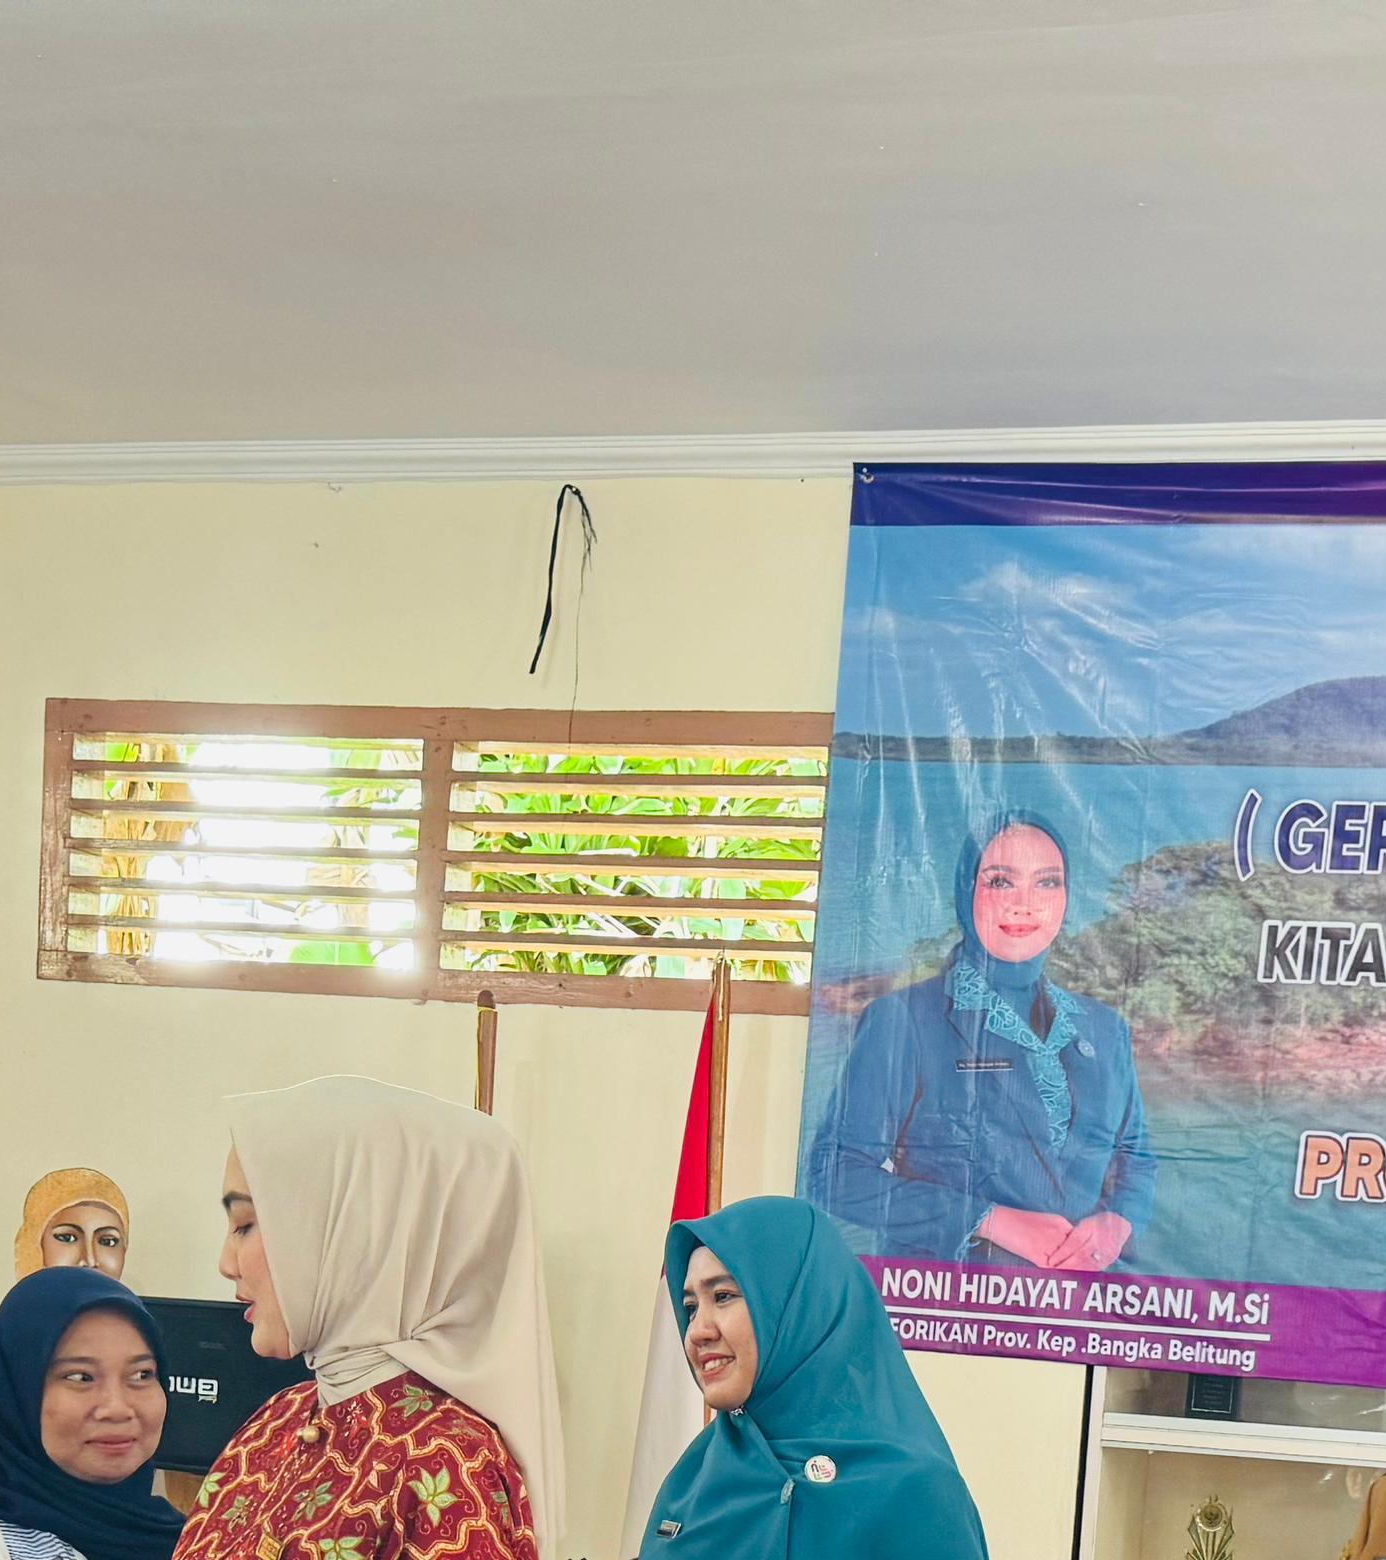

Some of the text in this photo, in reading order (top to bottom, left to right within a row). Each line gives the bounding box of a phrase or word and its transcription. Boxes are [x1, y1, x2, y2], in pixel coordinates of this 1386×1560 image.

[881, 1266, 1271, 1325] NONI HIDAYAT ARSANI, M.Si
[982, 1324, 1031, 1349] Prov.
[1167, 1338, 1257, 1373] Belitung
